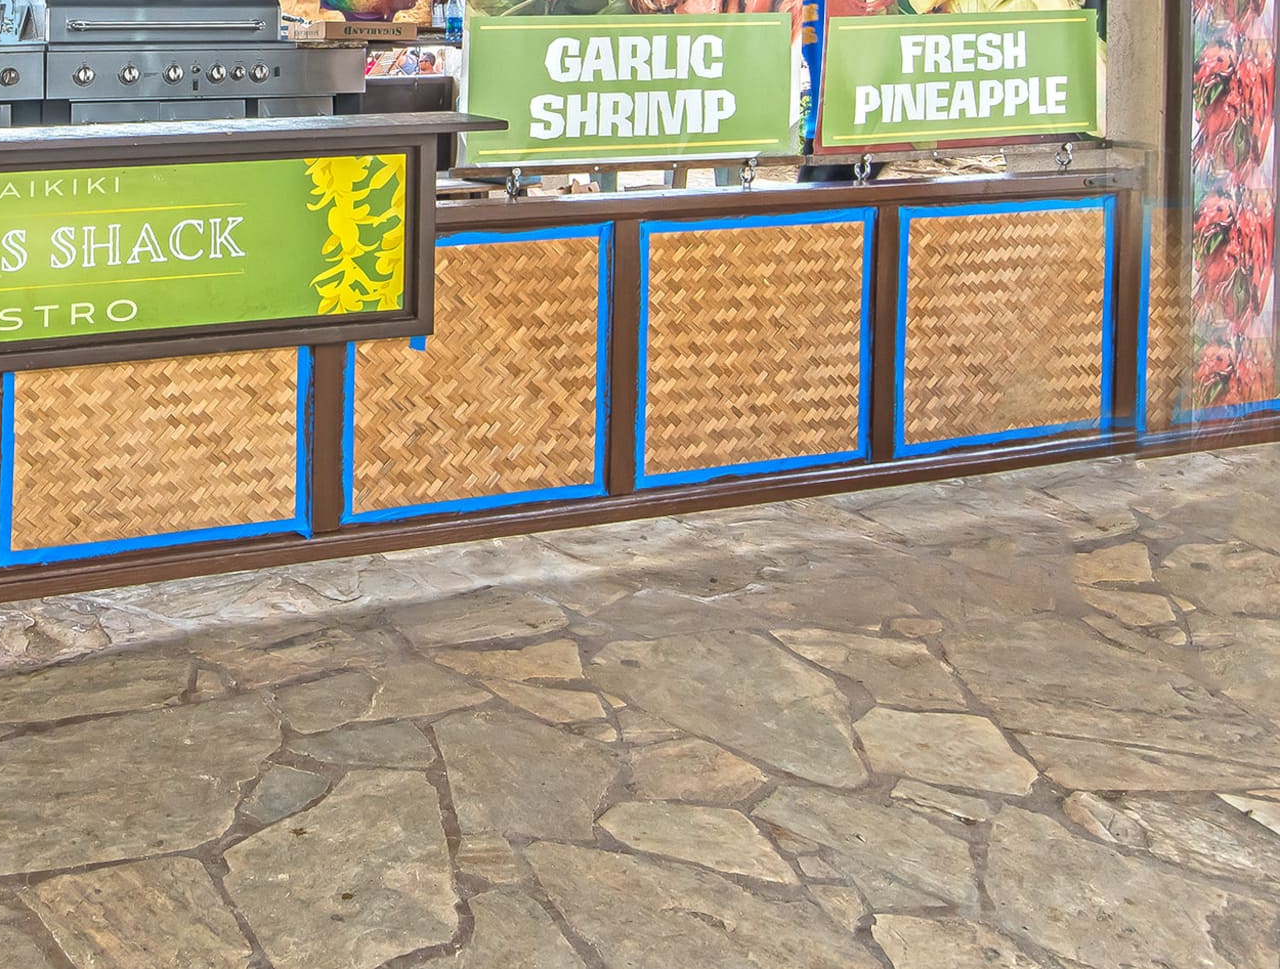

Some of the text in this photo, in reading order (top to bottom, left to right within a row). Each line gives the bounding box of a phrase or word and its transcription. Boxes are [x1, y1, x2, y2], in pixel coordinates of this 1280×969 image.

[545, 34, 724, 82] GARLIC
[900, 30, 1027, 75] FRESH
[529, 88, 736, 140] SHRIMP
[854, 75, 1068, 125] PINEAPPLE
[50, 216, 246, 269] SHACK
